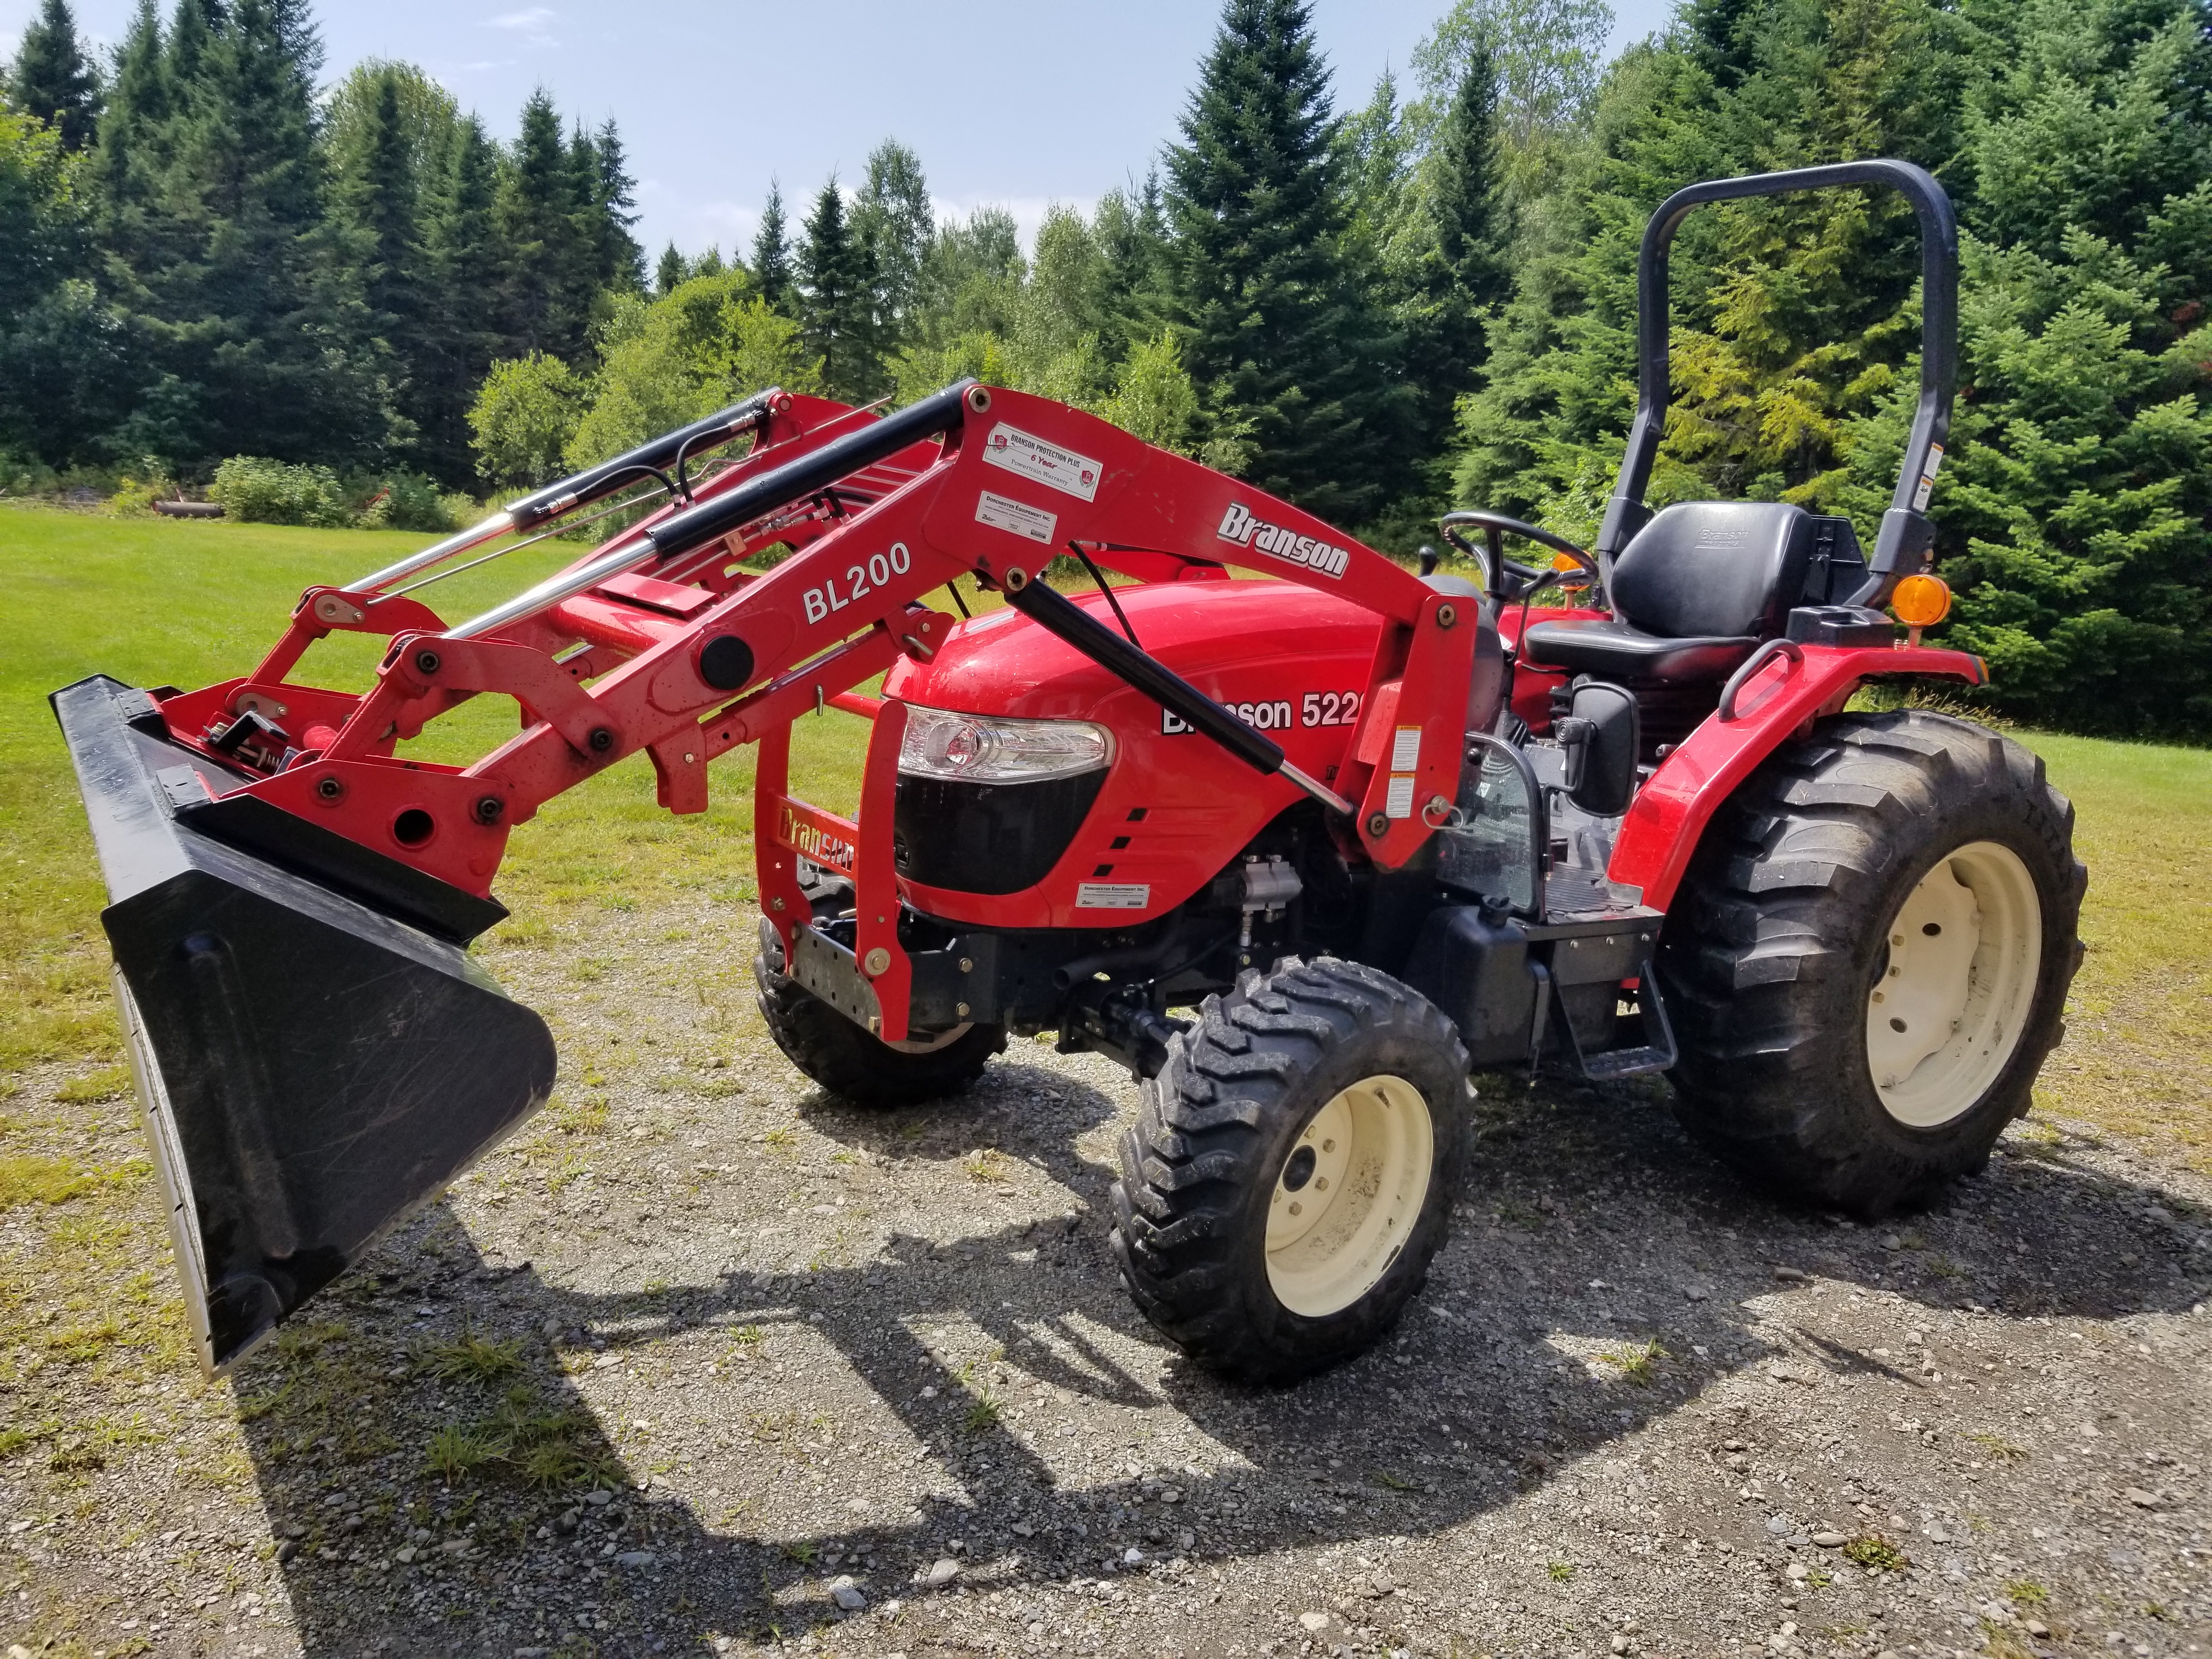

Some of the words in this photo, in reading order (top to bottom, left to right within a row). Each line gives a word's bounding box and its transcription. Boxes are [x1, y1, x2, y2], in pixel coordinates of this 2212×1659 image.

[1011, 434, 1035, 450] BRANSON
[1036, 444, 1066, 463] PROTECTION
[1067, 457, 1081, 468] PLUS
[1038, 456, 1058, 470] Year
[1011, 459, 1042, 475] Powertrain
[1043, 471, 1069, 486] Warranty
[986, 495, 1014, 510] DORCHESTER
[1015, 504, 1042, 518] ÉQUIPEMENT
[1217, 501, 1350, 580] Branson
[803, 542, 911, 625] BL200
[1301, 691, 1365, 727] 522
[779, 806, 855, 873] Branson
